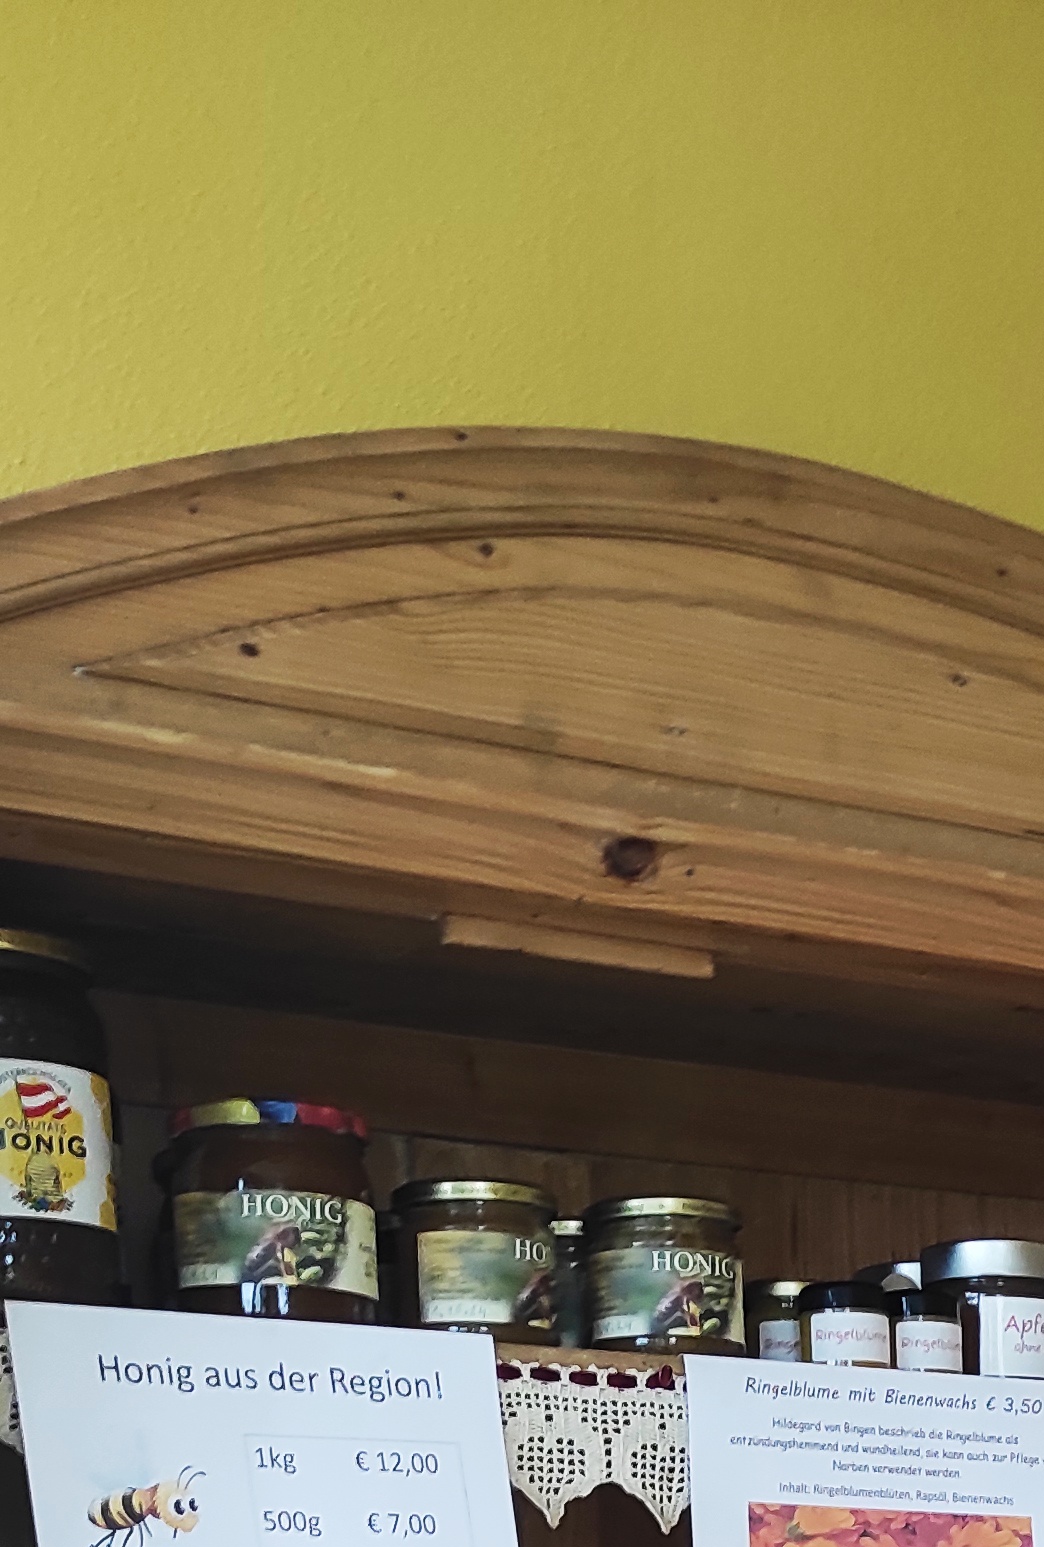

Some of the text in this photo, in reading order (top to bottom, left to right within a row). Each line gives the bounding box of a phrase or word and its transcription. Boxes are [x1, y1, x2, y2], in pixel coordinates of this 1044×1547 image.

[241, 1193, 343, 1224] HONIG
[98, 1354, 444, 1403] Honig aus der Region!
[745, 1376, 1043, 1417] Ringelblume mit Bienenwachs € 3,50
[772, 1416, 1020, 1445] Hildegard von Bingen beschrieb die Ringelblume als
[255, 1447, 439, 1477] 1kg € 12,00
[832, 1459, 870, 1473] Narben
[872, 1464, 923, 1477] verwendet
[841, 1441, 860, 1453] und
[925, 1449, 939, 1459] sie
[942, 1449, 965, 1460] kann
[967, 1451, 989, 1462] auch
[992, 1453, 1007, 1463] zur
[1010, 1452, 1040, 1468] Pflege
[916, 1489, 950, 1504] Rapsöl,
[952, 1491, 1015, 1506] Bienenwachs
[263, 1510, 437, 1539] 500g € 7,00
